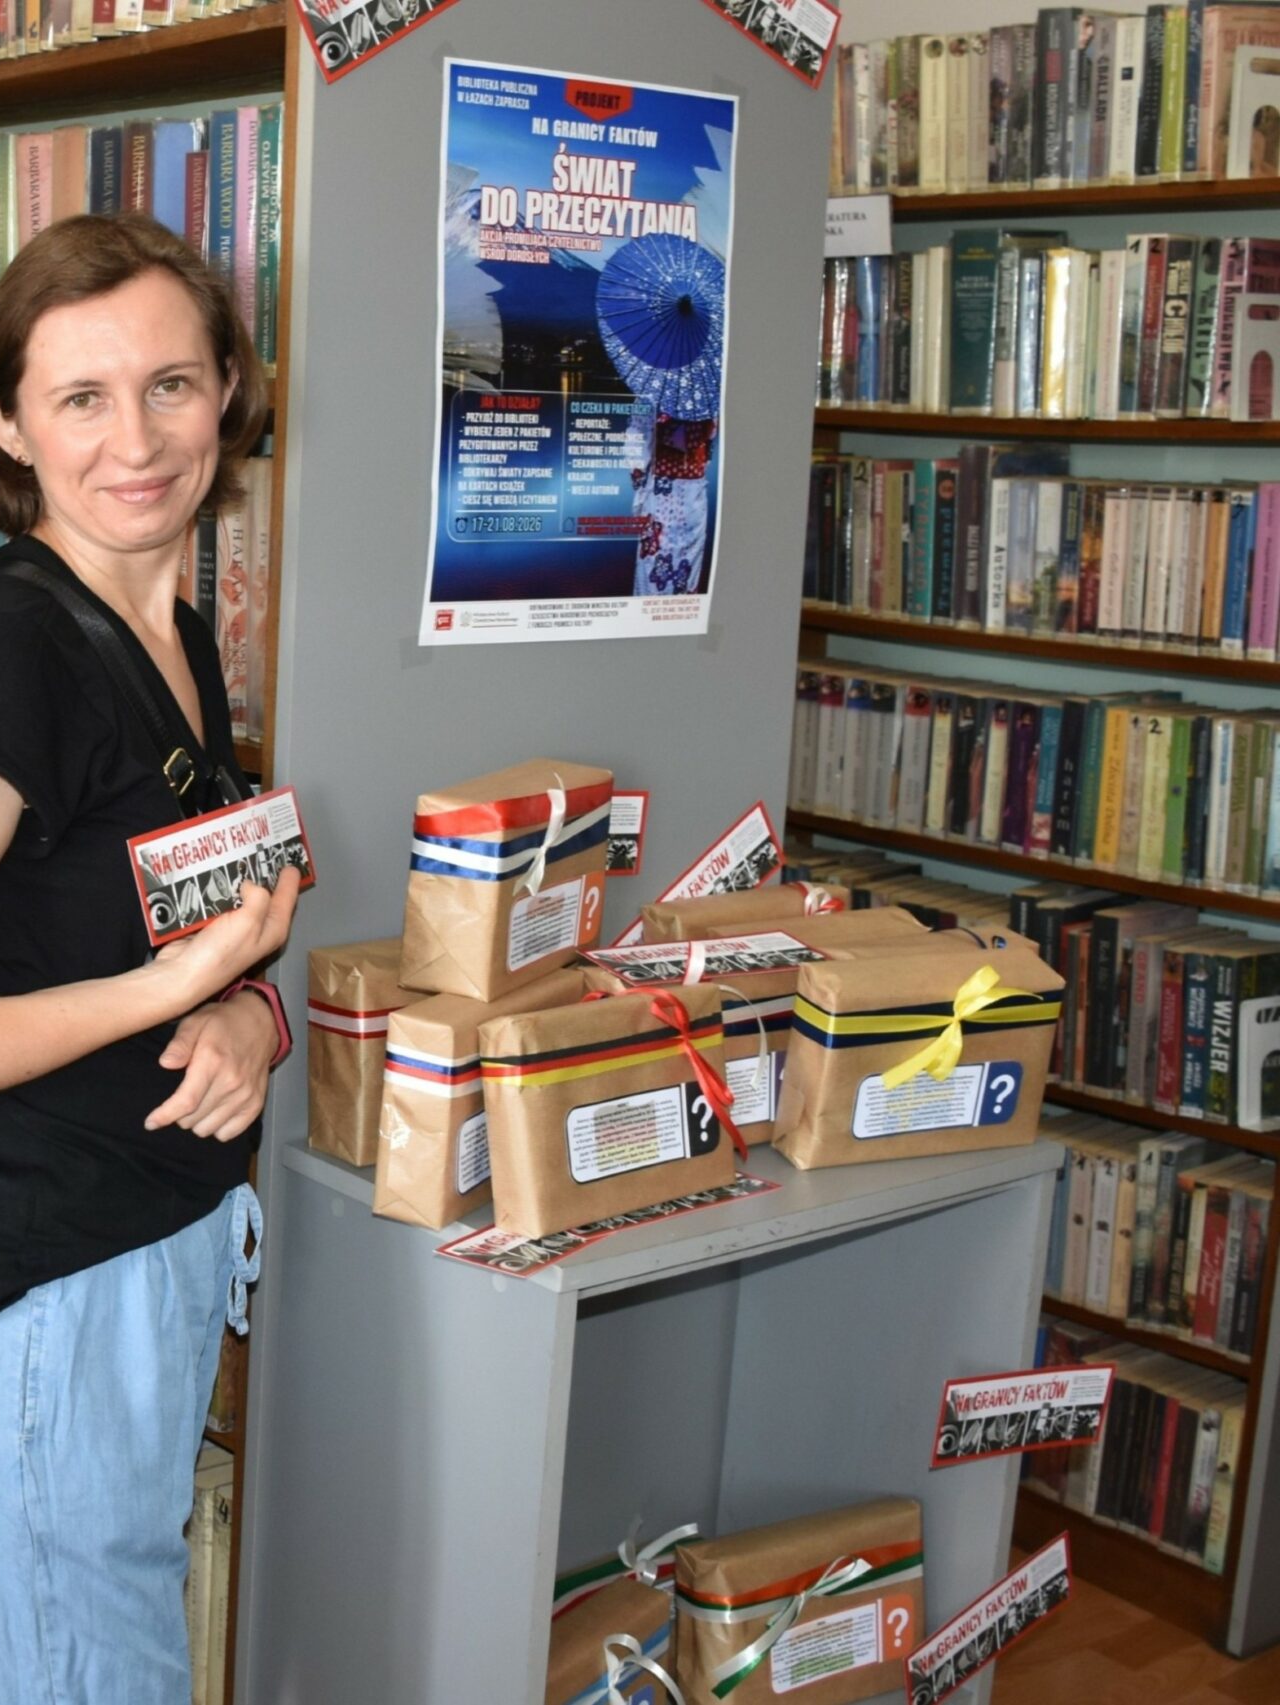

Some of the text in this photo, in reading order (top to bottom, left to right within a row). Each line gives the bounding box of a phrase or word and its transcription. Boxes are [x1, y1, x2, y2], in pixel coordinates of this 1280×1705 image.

[457, 76, 538, 96] BIBLIOTEKA PUBLICZNA
[465, 93, 494, 106] ŁAZACH
[495, 96, 530, 110] ZAPRASZA
[576, 91, 621, 110] PROJEKT
[221, 124, 234, 181] BARBARA
[532, 118, 658, 148] NA GRANICY FAKTÓW
[29, 146, 40, 202] BARBARA
[104, 140, 114, 198] BARBARA
[553, 142, 636, 198] ŚWIAT
[220, 183, 234, 229] WOOD
[259, 140, 271, 267] ZIELONE MIASTO
[481, 185, 697, 243] DO PRZECZYTANIA
[269, 228, 277, 243] W
[1150, 238, 1161, 254] 2
[472, 516, 542, 532] 17-21.08.2026
[993, 545, 1006, 609] Autorka
[1149, 718, 1163, 735] 2
[151, 853, 172, 877] NA
[172, 829, 230, 869] GRANICY
[231, 811, 270, 848] FAKTÓW
[688, 848, 731, 899] FAKTÓW
[704, 941, 751, 953] AKTÓW
[1210, 1001, 1233, 1073] WIZJER
[990, 1074, 1015, 1115] ?
[955, 1393, 970, 1413] NA
[972, 1384, 1022, 1411] GRANICY
[1023, 1375, 1069, 1403] FAKTÓW
[887, 1608, 909, 1647] ?
[918, 1573, 1029, 1672] NA GRANICY FAKTÓW
